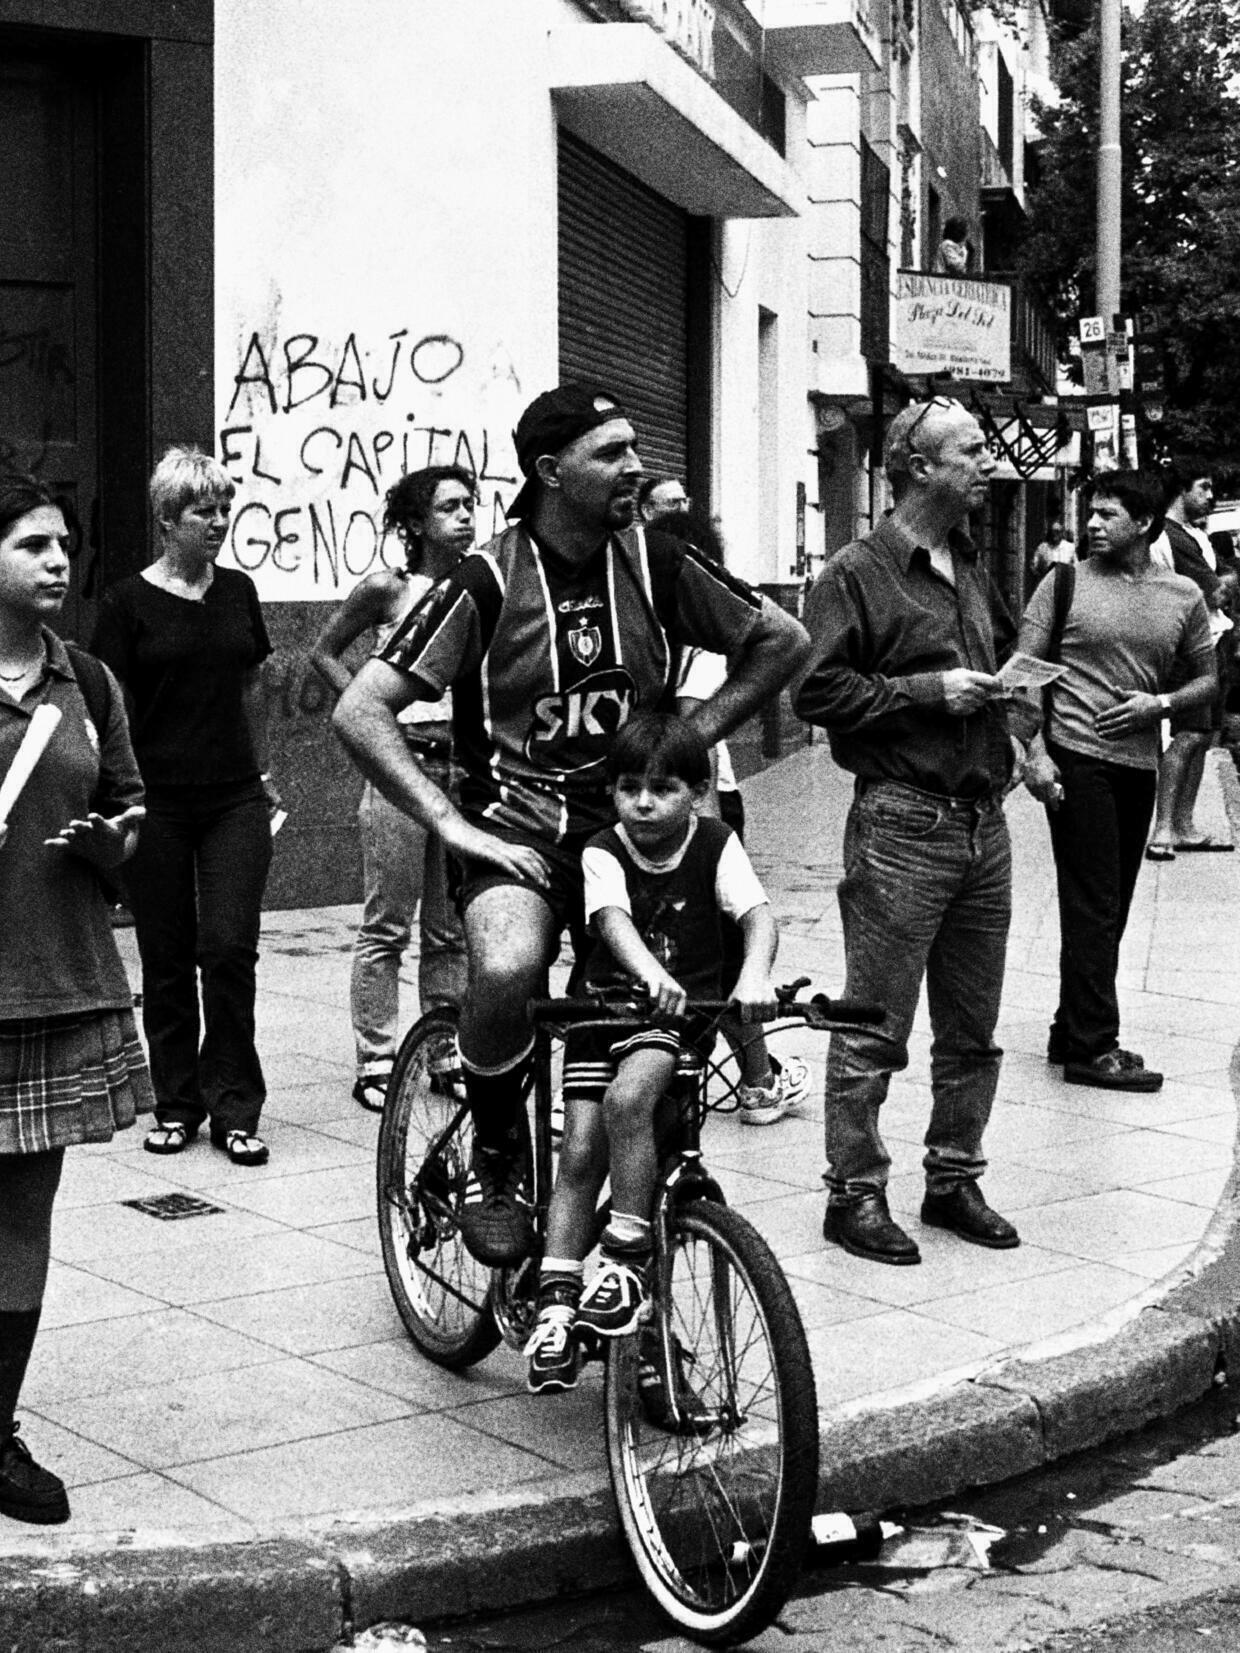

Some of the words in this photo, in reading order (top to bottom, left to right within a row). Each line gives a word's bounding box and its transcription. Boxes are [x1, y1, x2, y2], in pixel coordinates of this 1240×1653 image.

[1083, 321, 1101, 338] 26
[225, 329, 464, 422] ABAJO
[220, 425, 282, 486] EL
[300, 413, 517, 496] CAPITAL
[535, 688, 631, 741] SKY
